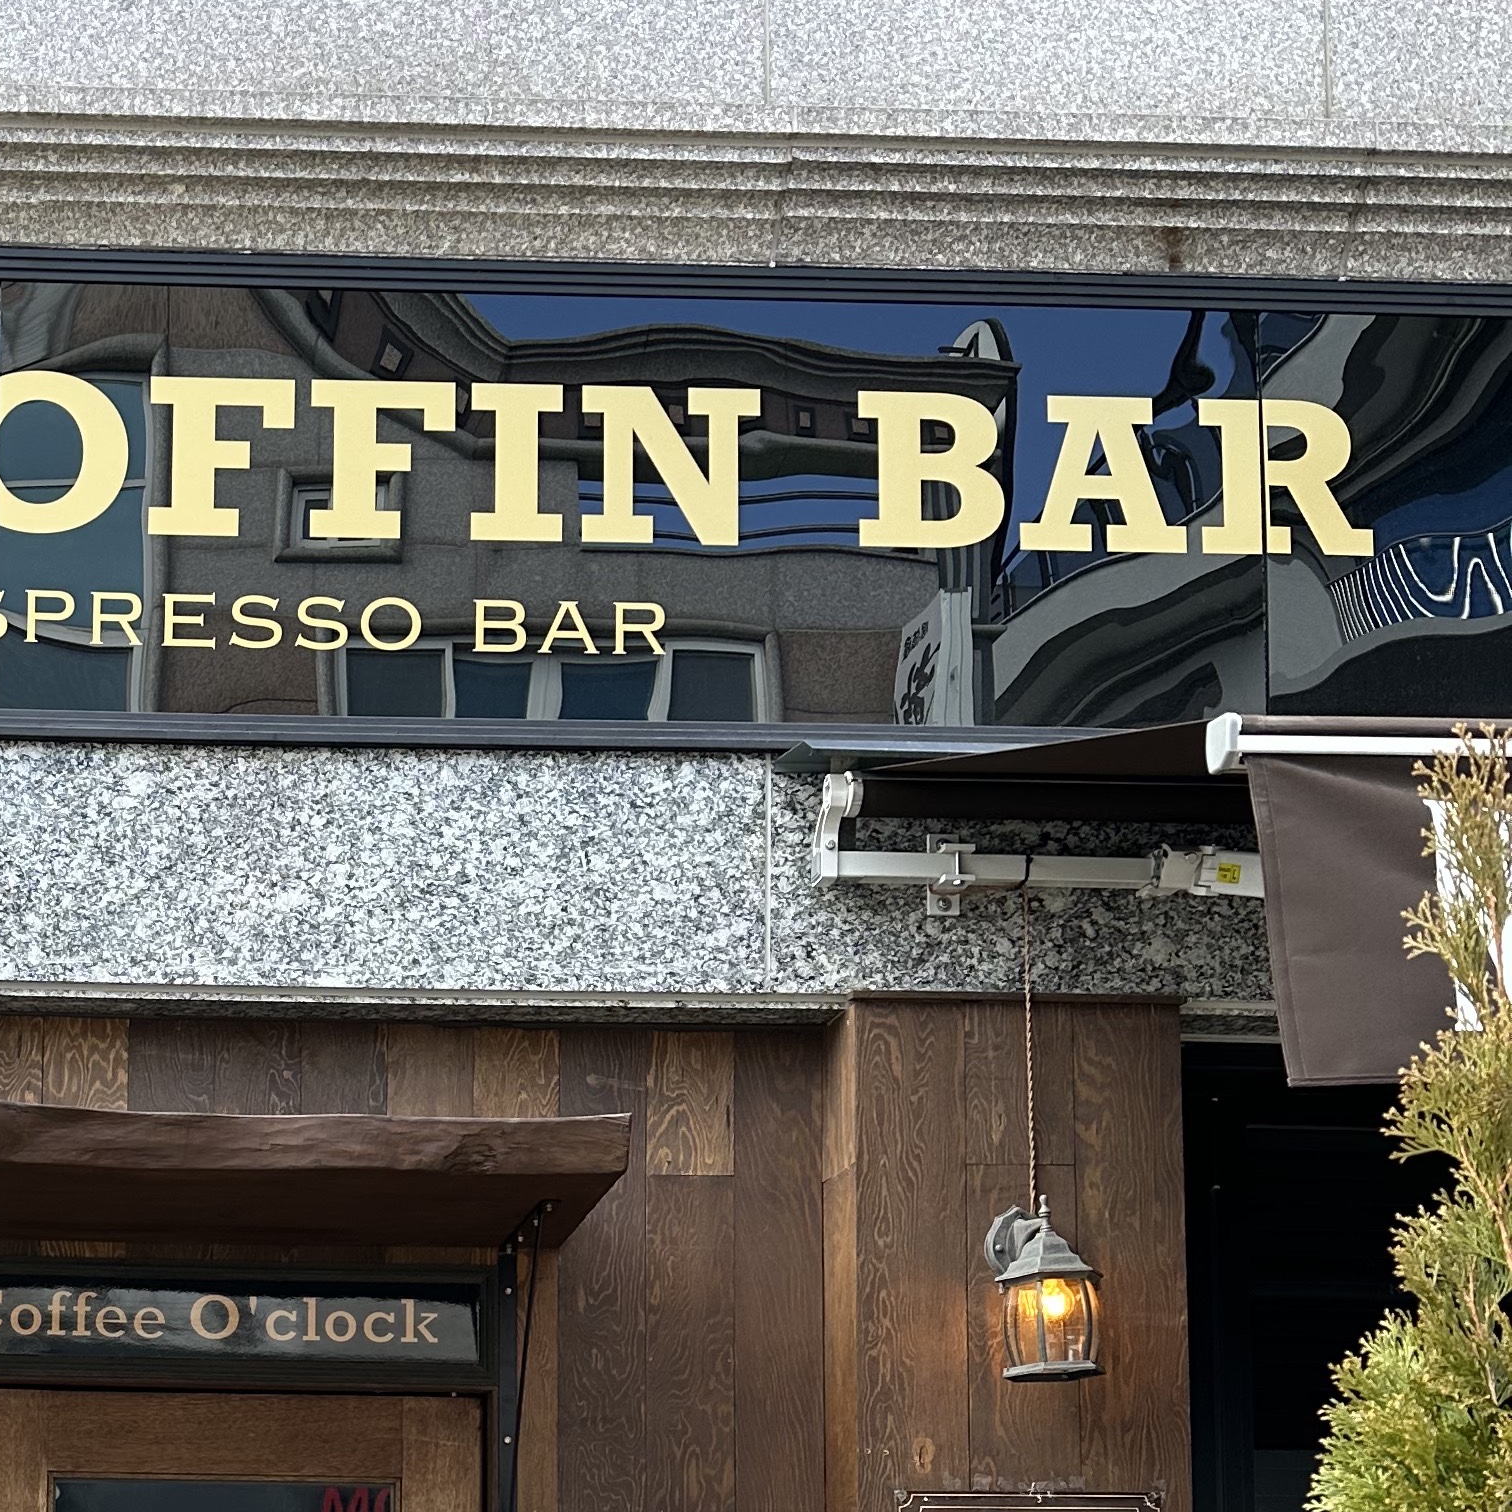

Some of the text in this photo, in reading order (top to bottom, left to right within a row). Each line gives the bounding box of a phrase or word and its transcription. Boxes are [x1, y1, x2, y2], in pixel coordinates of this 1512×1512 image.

[857, 389, 1375, 557] BAR
[472, 598, 669, 657] BAR
[190, 1293, 439, 1347] O'clock
